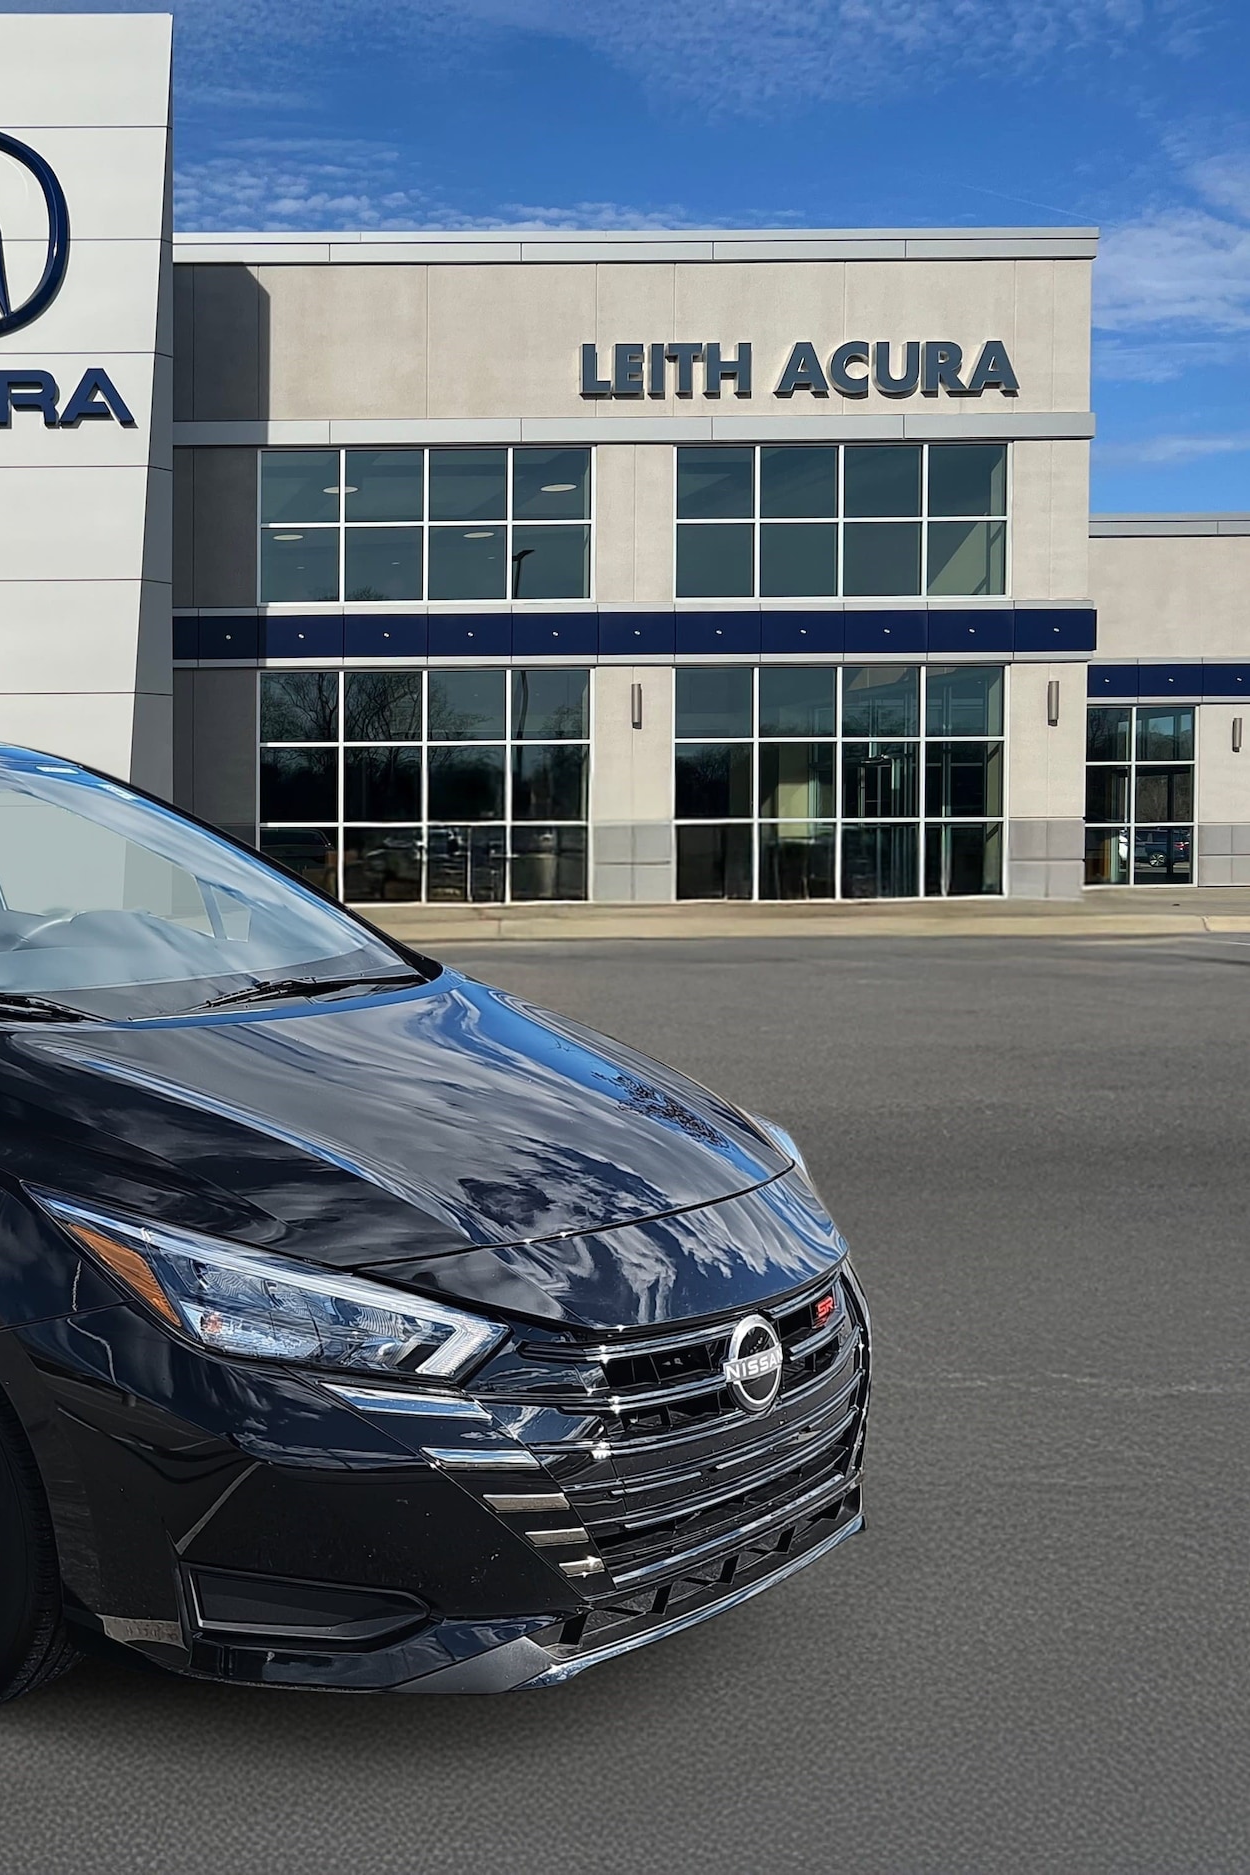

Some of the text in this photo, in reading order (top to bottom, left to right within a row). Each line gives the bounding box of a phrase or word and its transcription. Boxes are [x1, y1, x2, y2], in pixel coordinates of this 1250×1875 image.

[579, 340, 1020, 400] LEITH ACURA
[816, 1296, 833, 1317] SR
